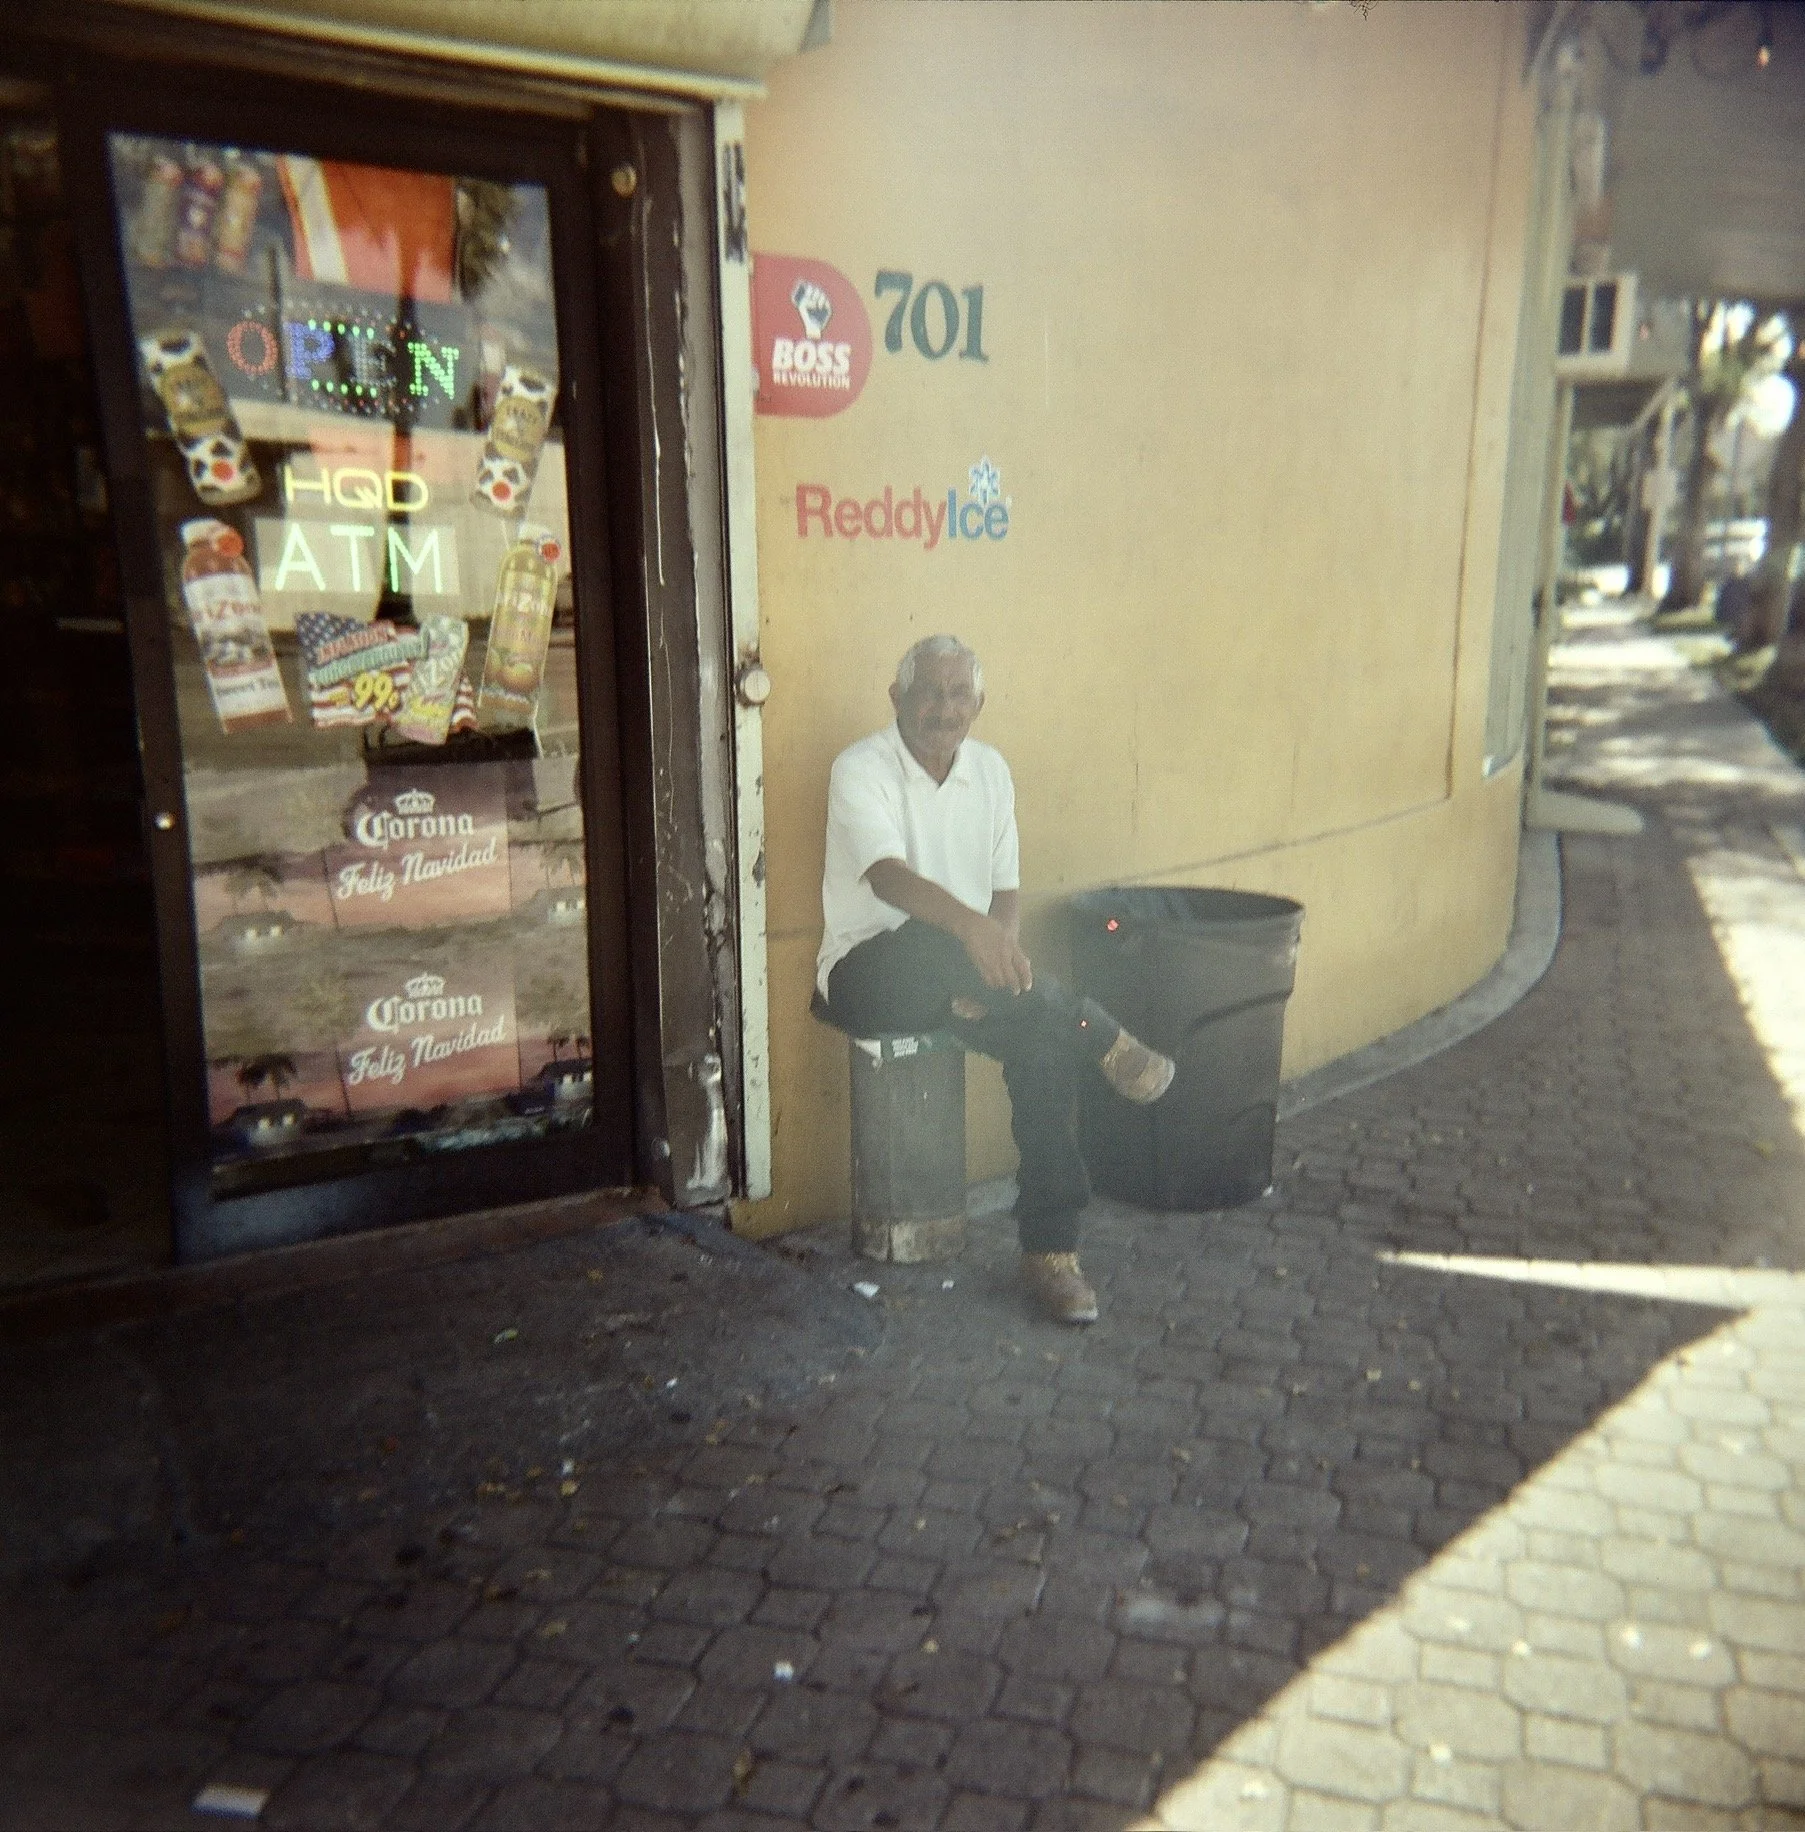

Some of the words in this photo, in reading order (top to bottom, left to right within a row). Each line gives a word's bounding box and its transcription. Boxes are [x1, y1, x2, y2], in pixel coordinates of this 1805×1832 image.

[873, 268, 991, 364] 701
[227, 319, 460, 400] OPEN
[771, 337, 852, 374] BOSS
[773, 371, 851, 390] REVOLUTION
[285, 465, 430, 512] HQD
[274, 523, 444, 594] ATM
[354, 811, 476, 850] Corona
[335, 861, 397, 903] Feliz
[400, 837, 498, 886] Navidad
[366, 991, 484, 1034] Corona
[348, 1050, 408, 1086] Feliz
[411, 1015, 506, 1068] Navidad
